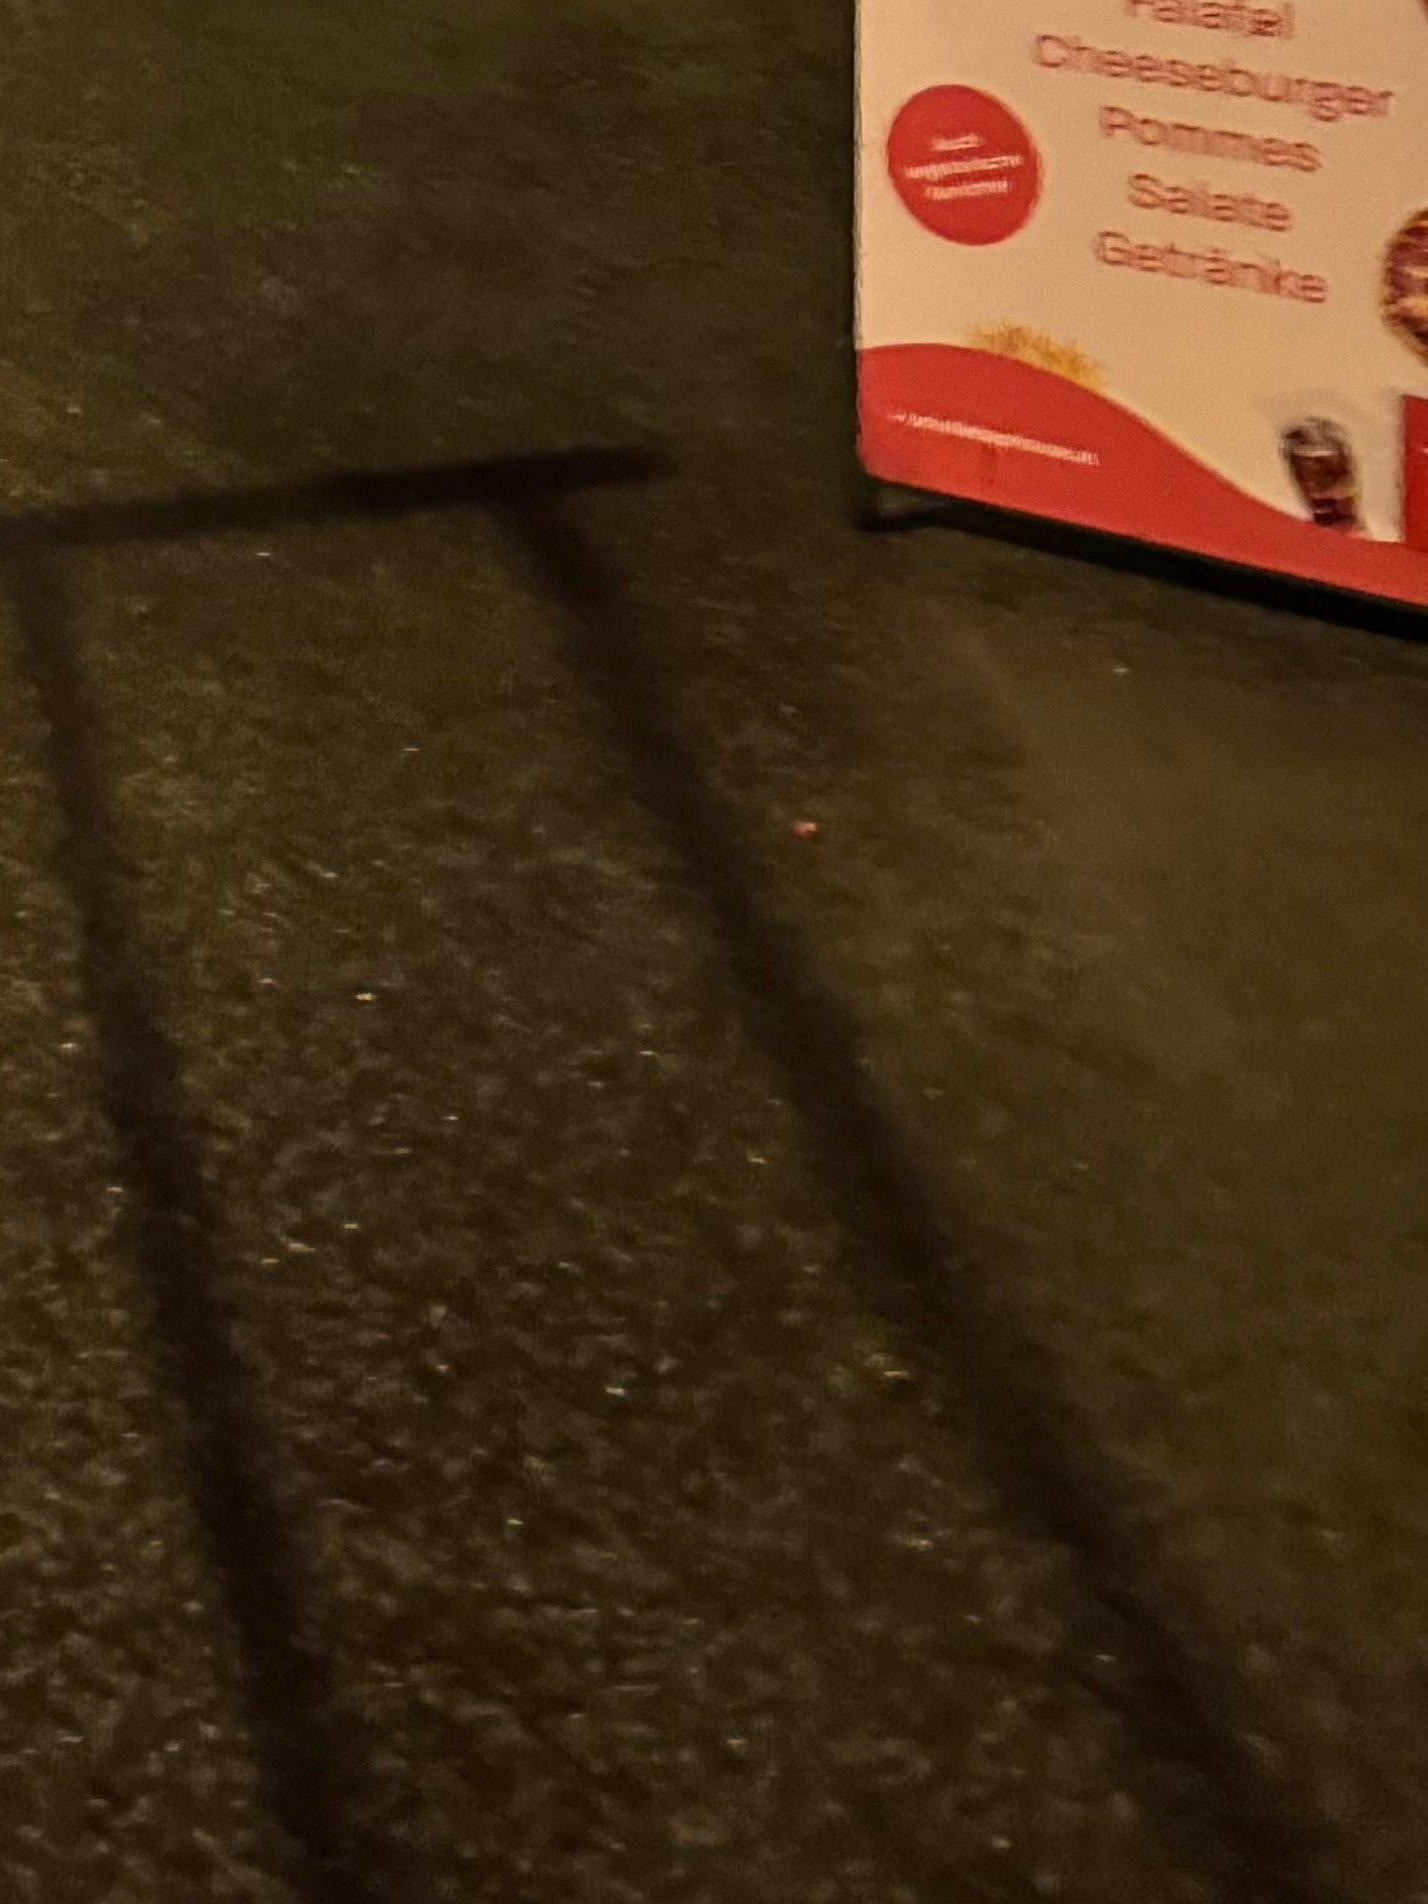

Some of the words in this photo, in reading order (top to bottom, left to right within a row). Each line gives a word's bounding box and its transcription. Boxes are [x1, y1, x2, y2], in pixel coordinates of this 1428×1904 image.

[1033, 34, 1395, 122] Cheeseburger
[1099, 106, 1323, 172] Pommes
[1127, 174, 1292, 232] Salate
[1092, 231, 1328, 303] Getränke
